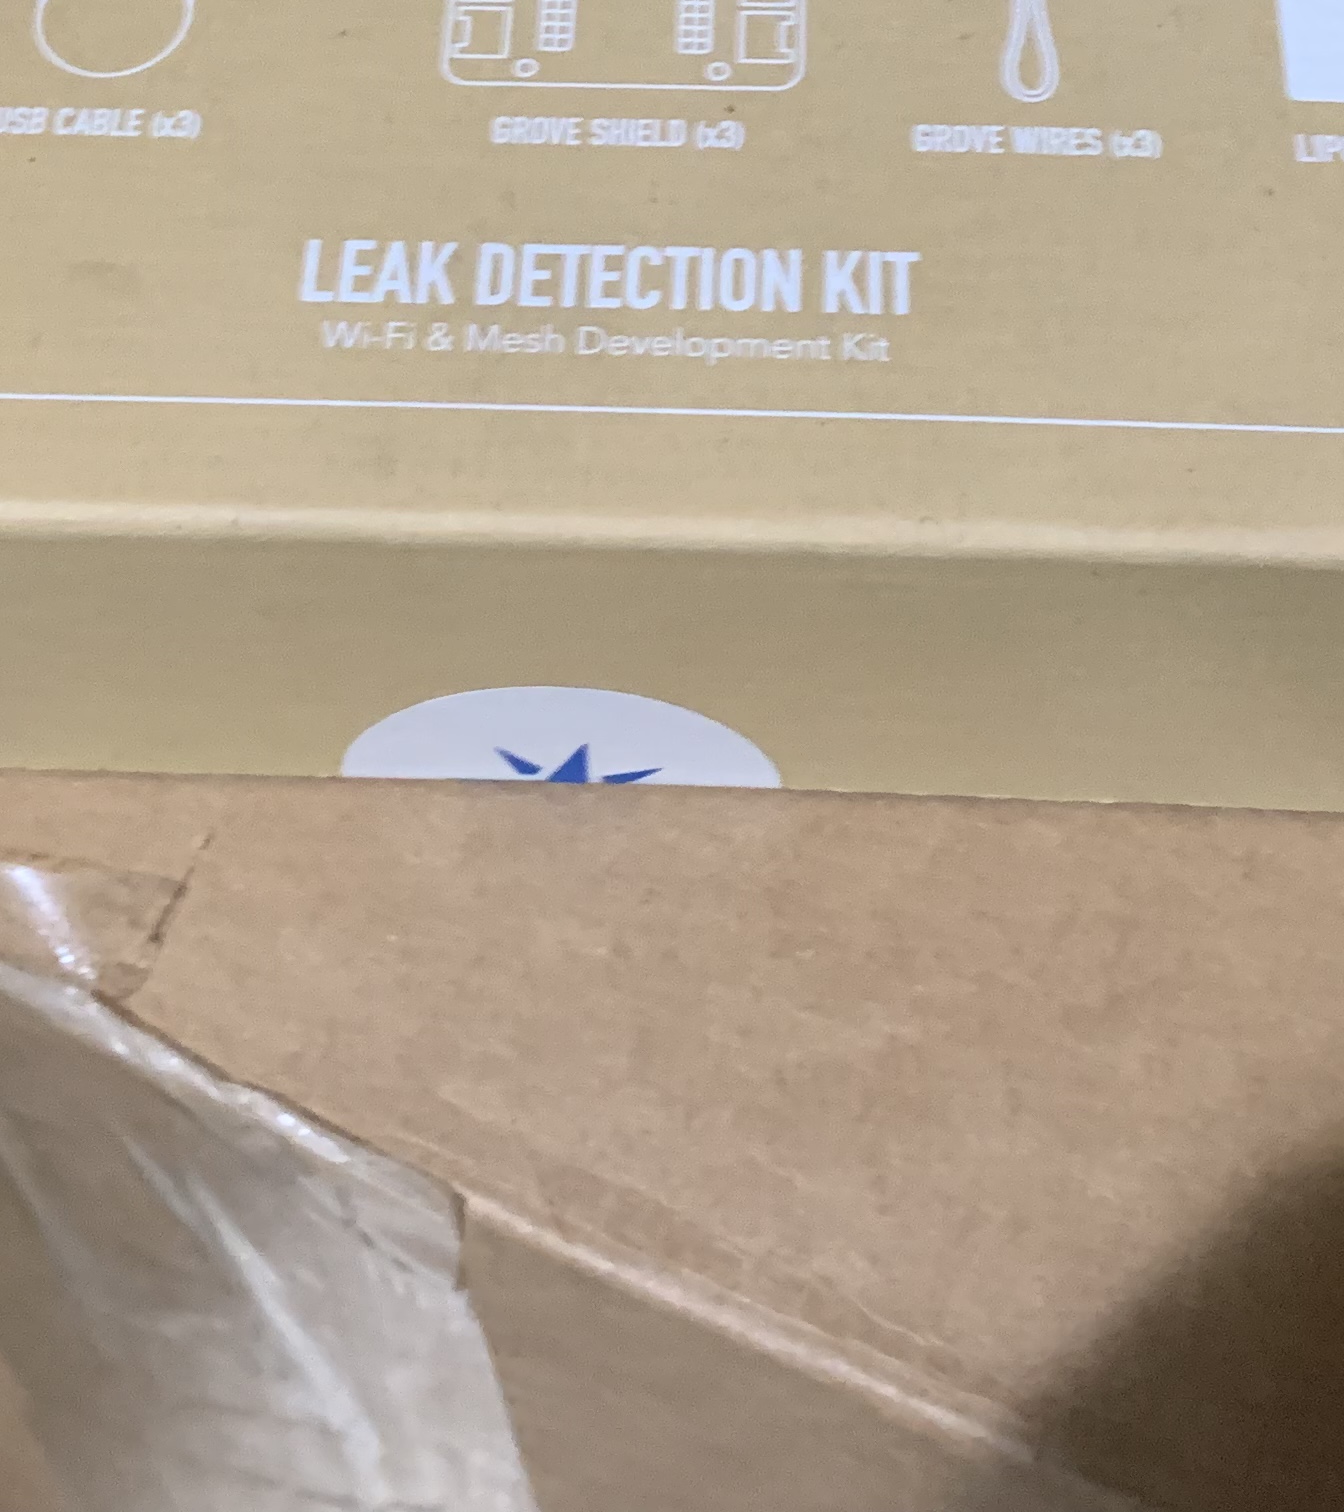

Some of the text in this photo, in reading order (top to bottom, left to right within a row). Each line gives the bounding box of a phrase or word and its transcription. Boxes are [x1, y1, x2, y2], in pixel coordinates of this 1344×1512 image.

[52, 107, 145, 137] CABLE
[489, 115, 584, 145] GROVE
[588, 117, 688, 147] SHIELD
[299, 238, 922, 316] LEAK DETECTION KIT
[322, 319, 891, 365] Wi-Fi & Mesh Development Kit
